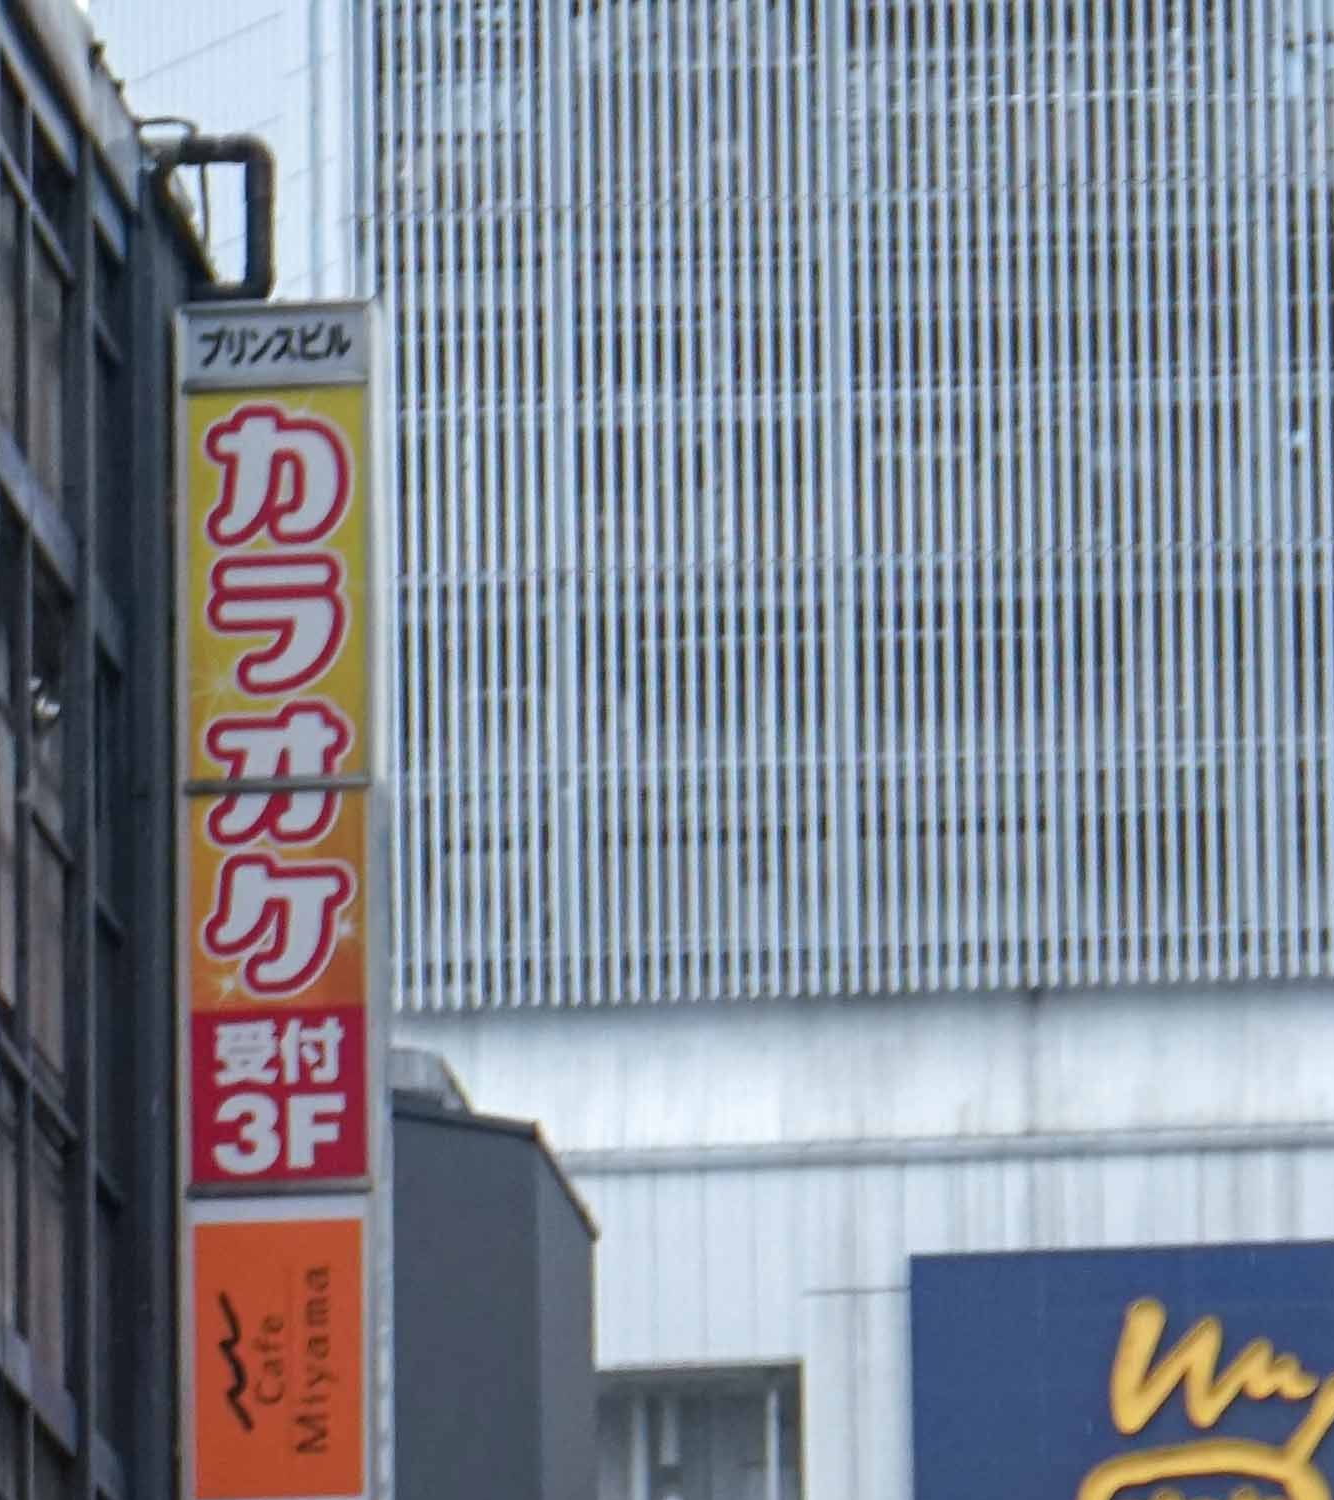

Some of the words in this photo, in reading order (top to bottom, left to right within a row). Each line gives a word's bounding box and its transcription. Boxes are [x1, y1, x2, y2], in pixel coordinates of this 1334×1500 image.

[199, 322, 352, 368] プリンスビル
[205, 402, 352, 998] カラオケ
[213, 1015, 344, 1085] 受付
[215, 1093, 347, 1178] 3F
[254, 1310, 286, 1405] Cafe
[293, 1262, 334, 1455] Miyama
